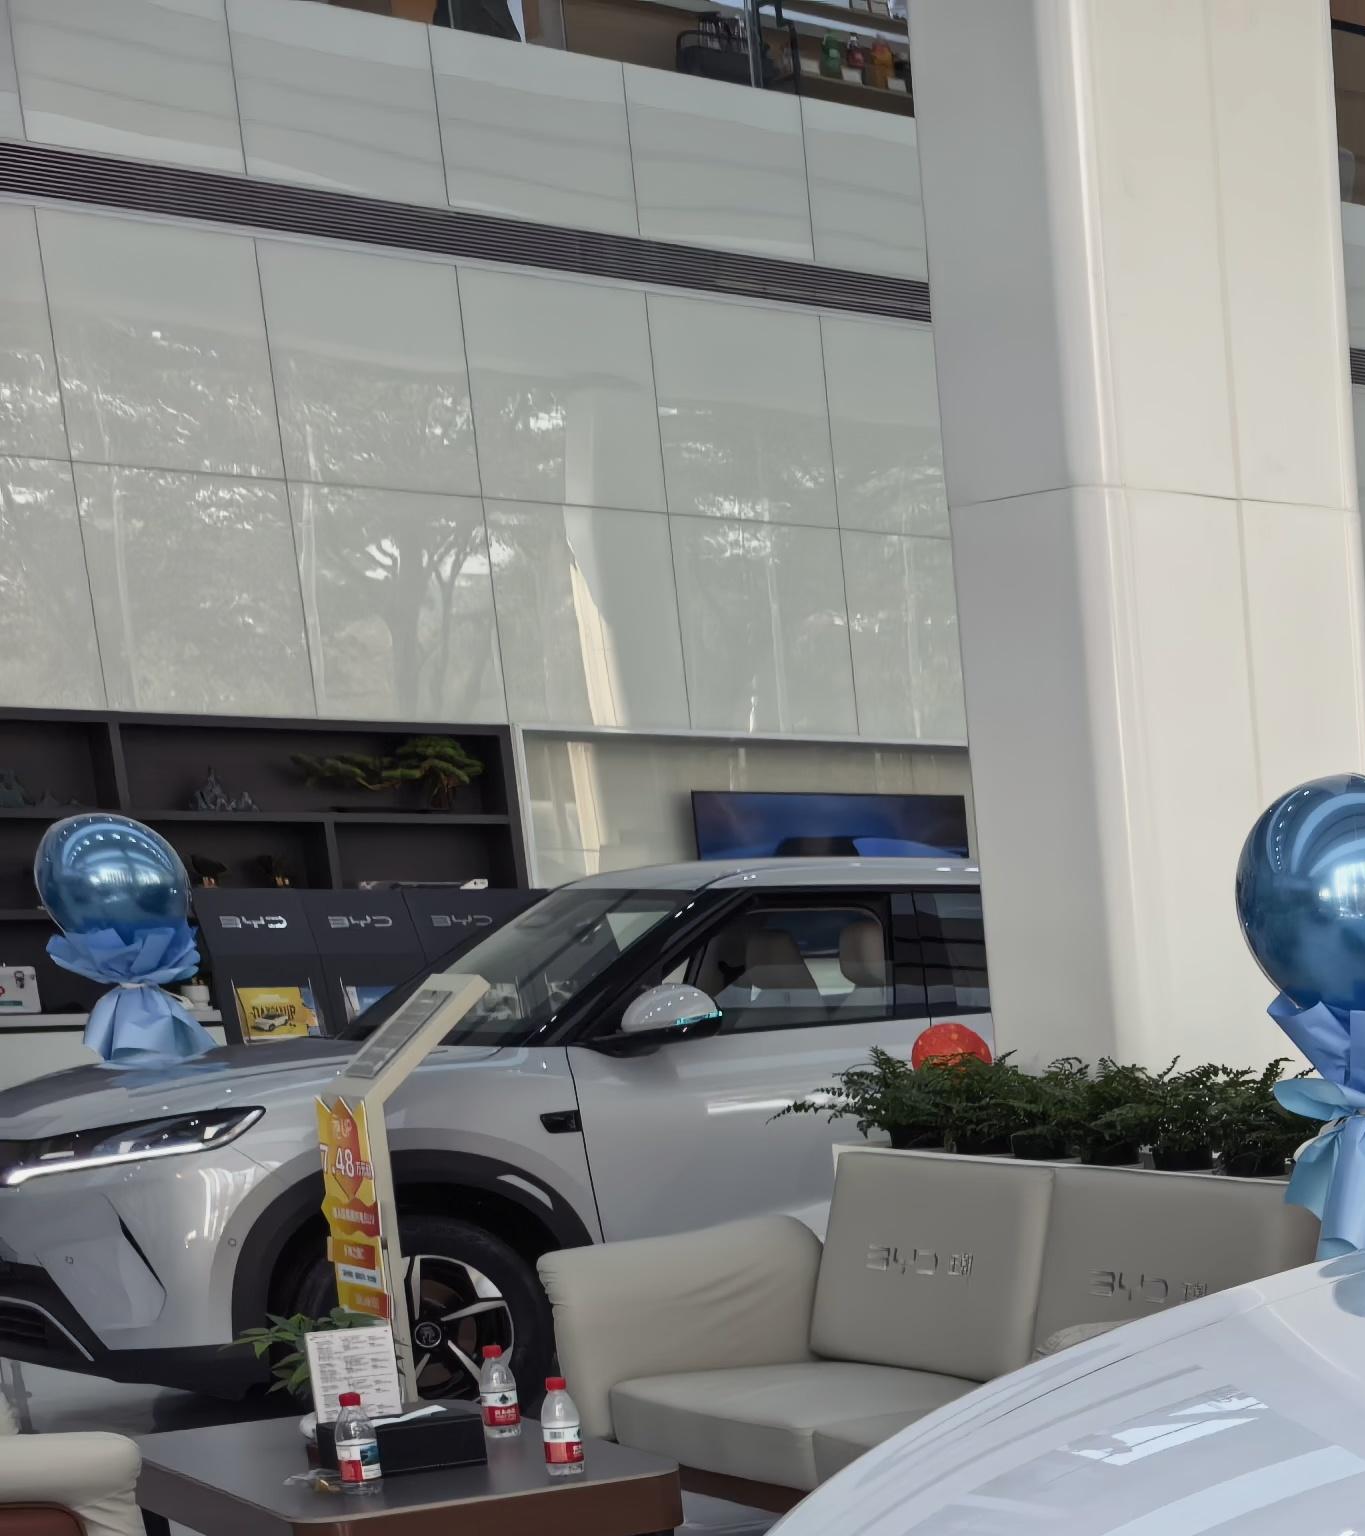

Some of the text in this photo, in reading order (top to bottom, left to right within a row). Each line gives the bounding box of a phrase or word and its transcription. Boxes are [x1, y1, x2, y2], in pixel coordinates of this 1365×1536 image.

[219, 915, 288, 929] BYD
[328, 915, 393, 929] BYD
[430, 914, 493, 928] BYD
[319, 1143, 354, 1178] 7.48
